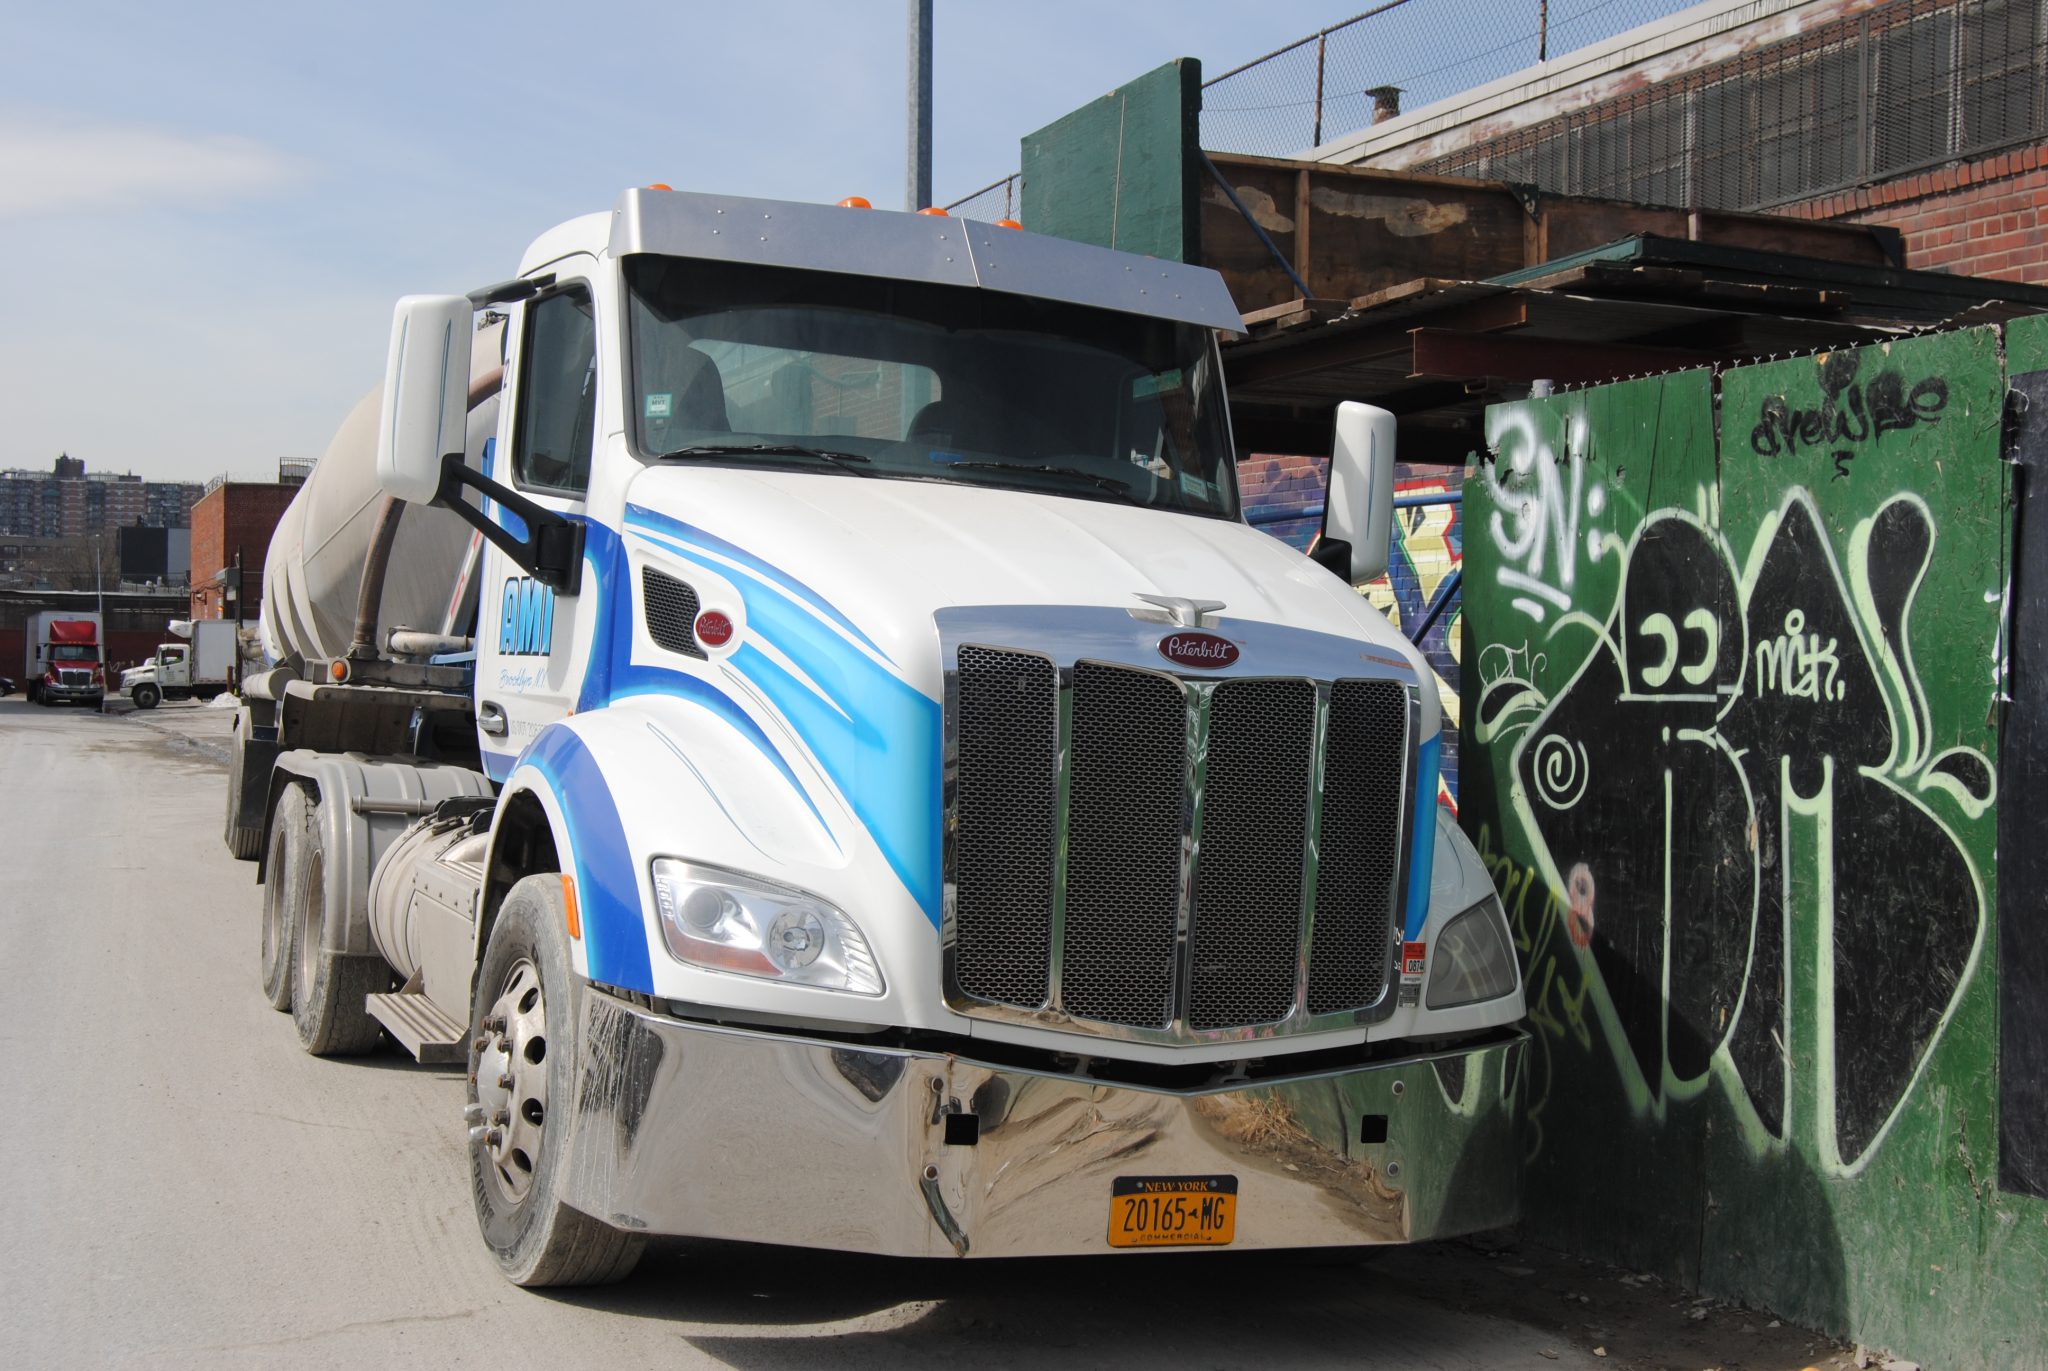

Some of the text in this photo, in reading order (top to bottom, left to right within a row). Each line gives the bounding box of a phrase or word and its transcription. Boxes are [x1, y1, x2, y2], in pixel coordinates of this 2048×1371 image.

[499, 576, 555, 656] AMI
[1169, 637, 1232, 659] Peterbilt
[1145, 1181, 1209, 1192] NEW YORK
[1140, 1232, 1206, 1241] COMMERCIAL
